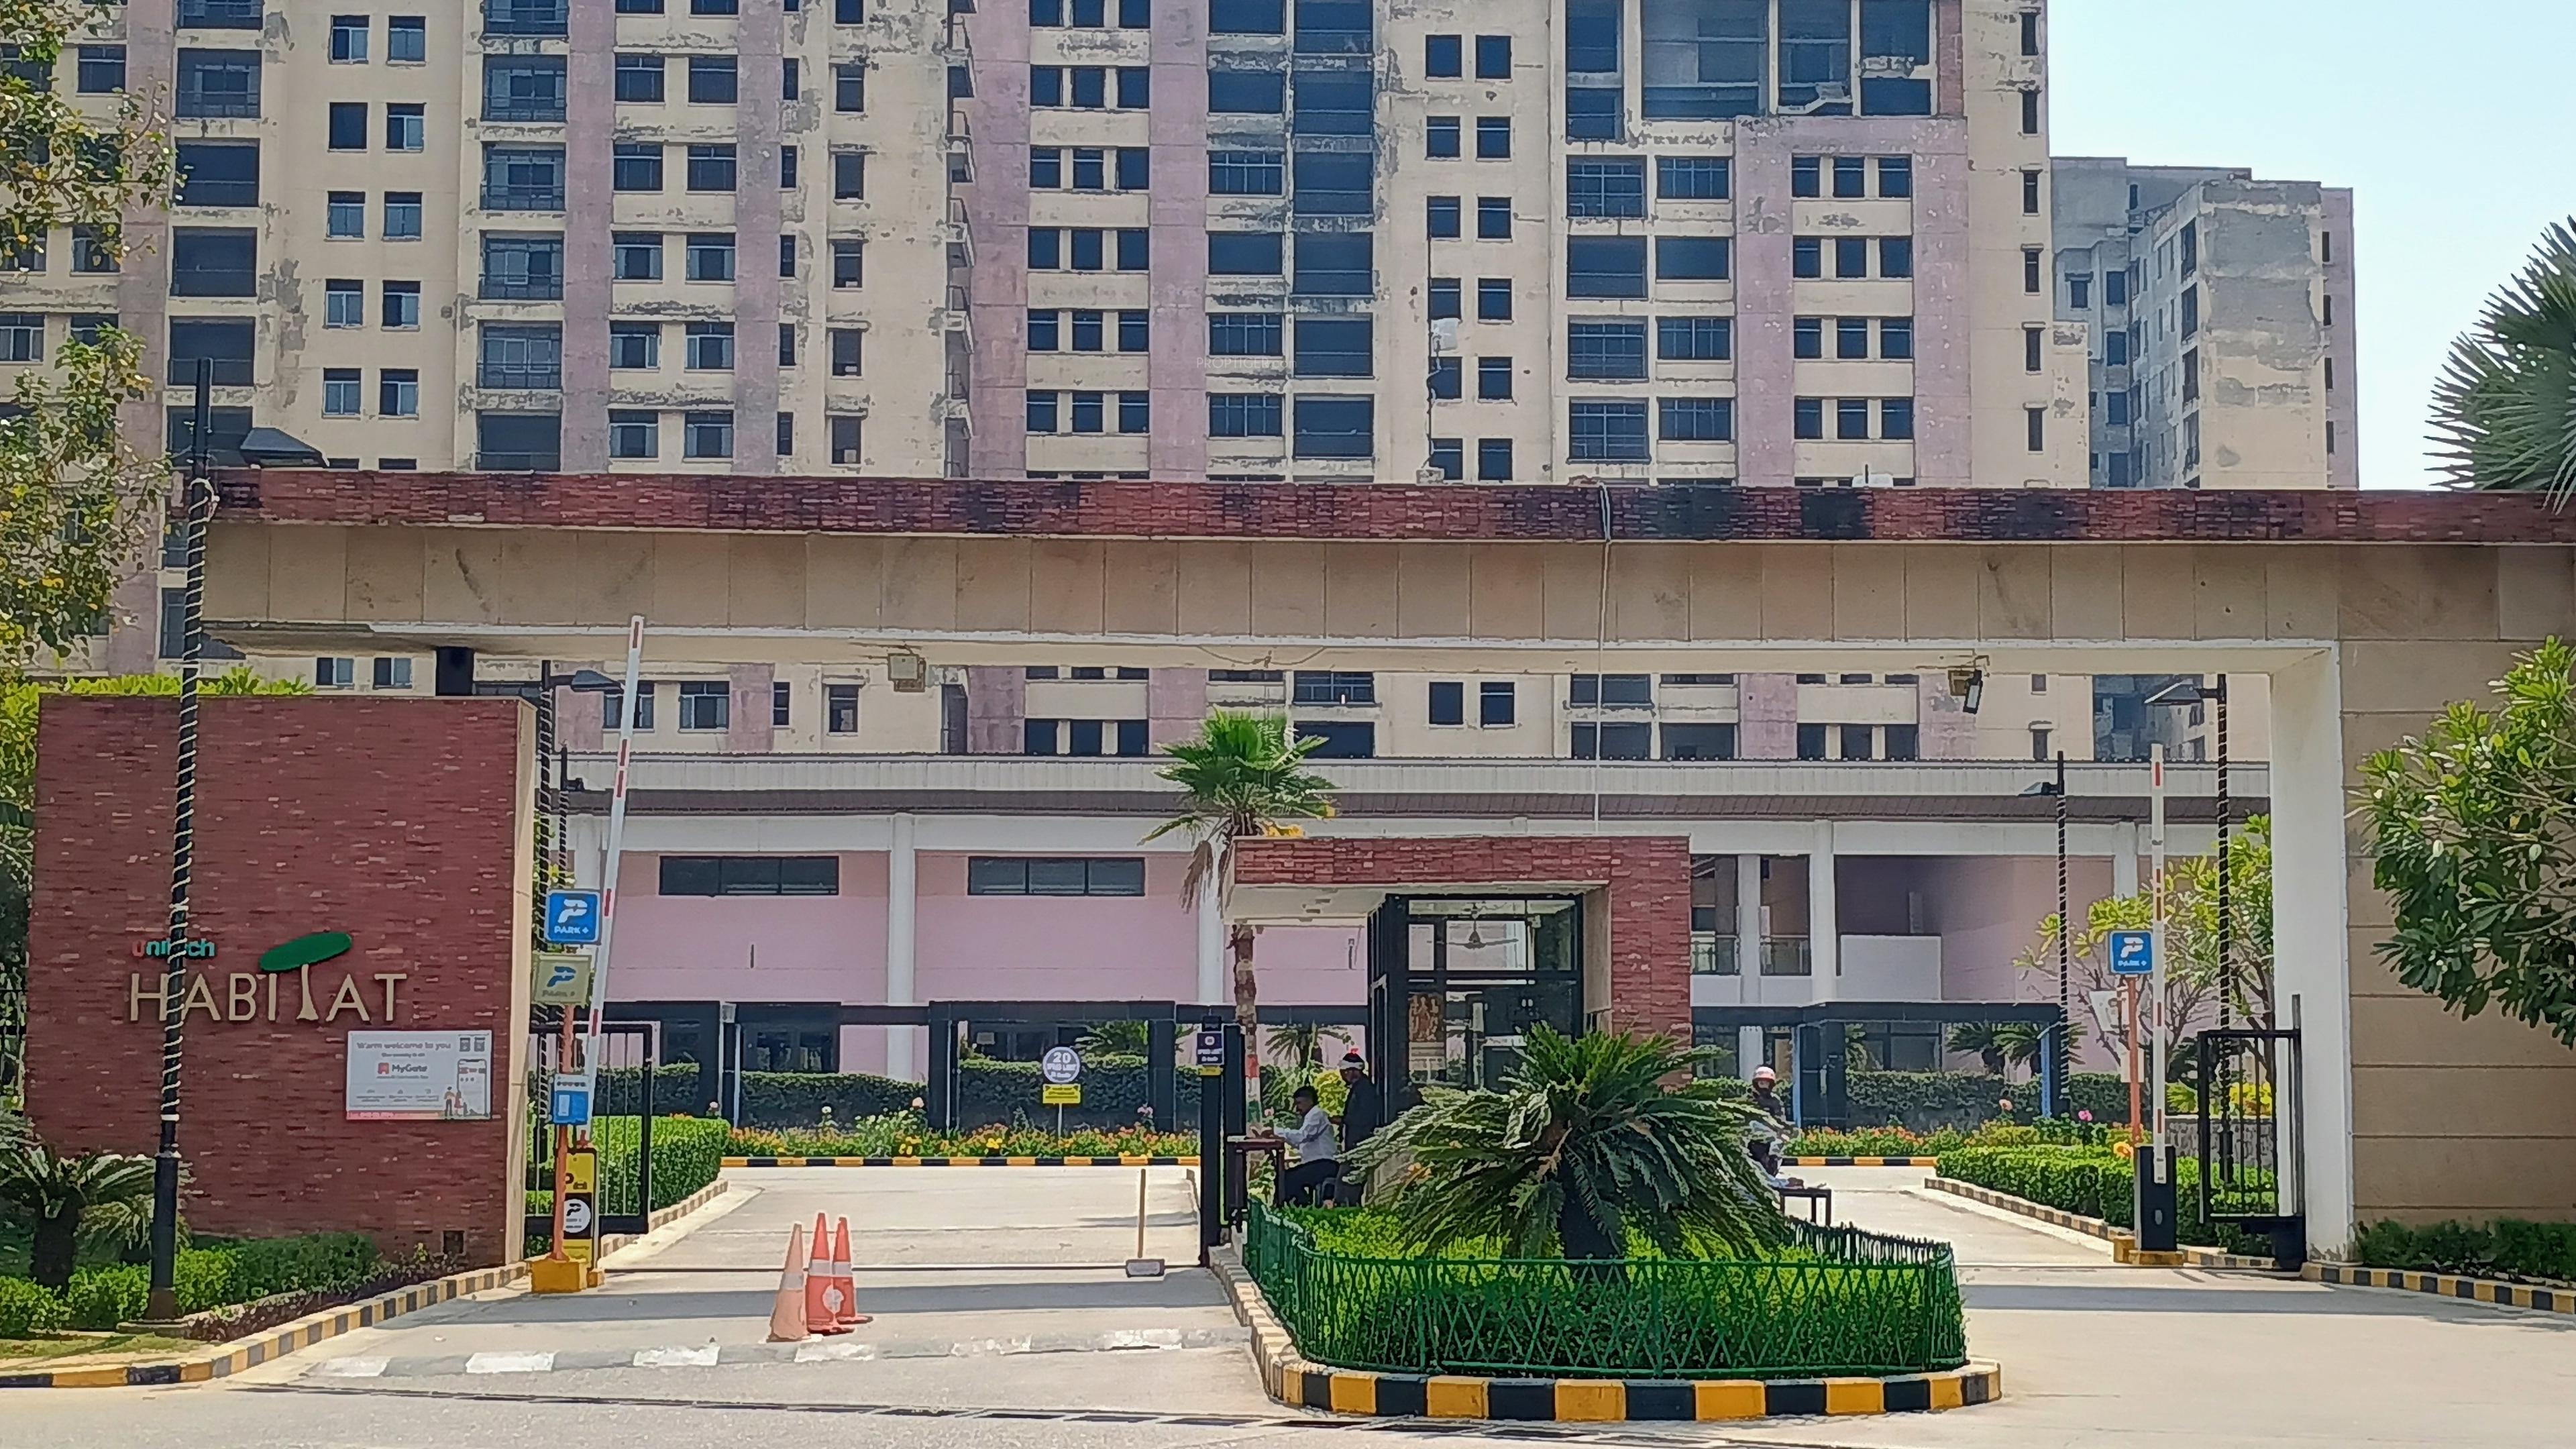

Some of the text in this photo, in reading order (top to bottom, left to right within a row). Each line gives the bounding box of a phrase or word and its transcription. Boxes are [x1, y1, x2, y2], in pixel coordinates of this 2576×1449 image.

[554, 925, 581, 934] PARK
[130, 964, 407, 1021] HABITAT
[435, 1043, 451, 1051] you
[1053, 1052, 1072, 1064] 20
